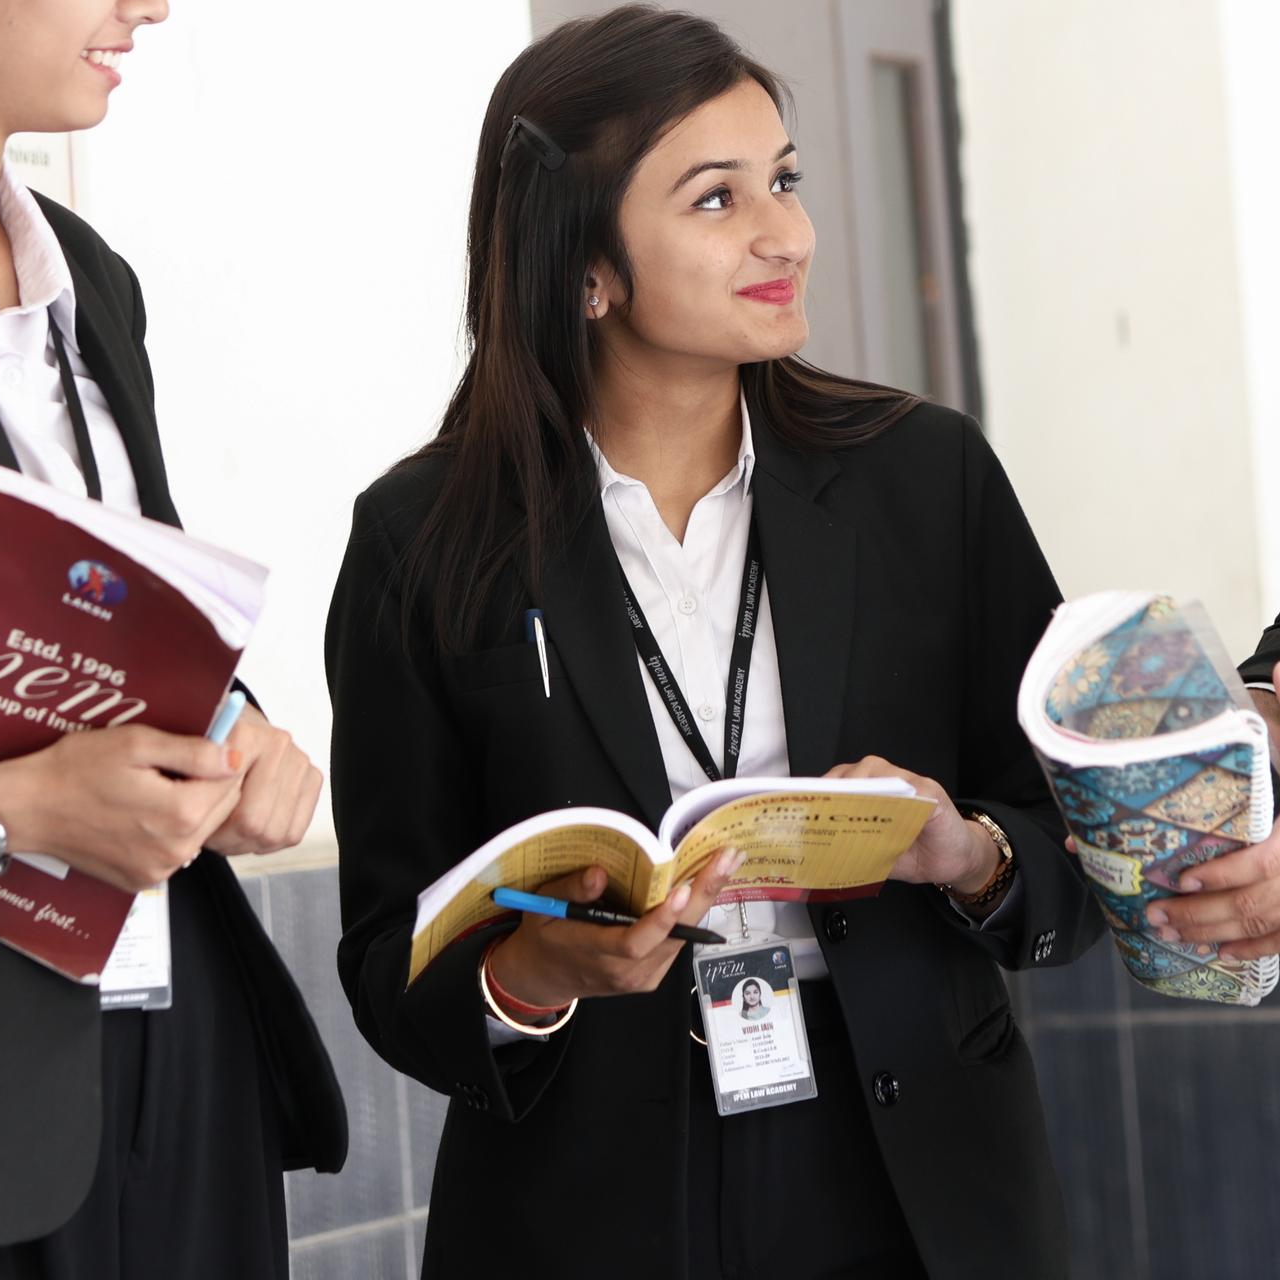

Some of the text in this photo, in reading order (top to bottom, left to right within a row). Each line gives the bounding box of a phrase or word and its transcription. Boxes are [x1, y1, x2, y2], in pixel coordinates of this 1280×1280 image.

[62, 592, 113, 622] LAKSH
[625, 597, 644, 629] ACADEMY
[738, 560, 759, 638] ipem LAW ACADEMY
[5, 627, 127, 687] Estd. 1996
[649, 655, 693, 737] ipem LAW ACADEMY
[728, 668, 745, 756] ipem LAW ACADEMY
[23, 706, 48, 723] of
[706, 962, 745, 983] ipem
[750, 1088, 765, 1099] LAW
[766, 1083, 797, 1094] ACADEMY
